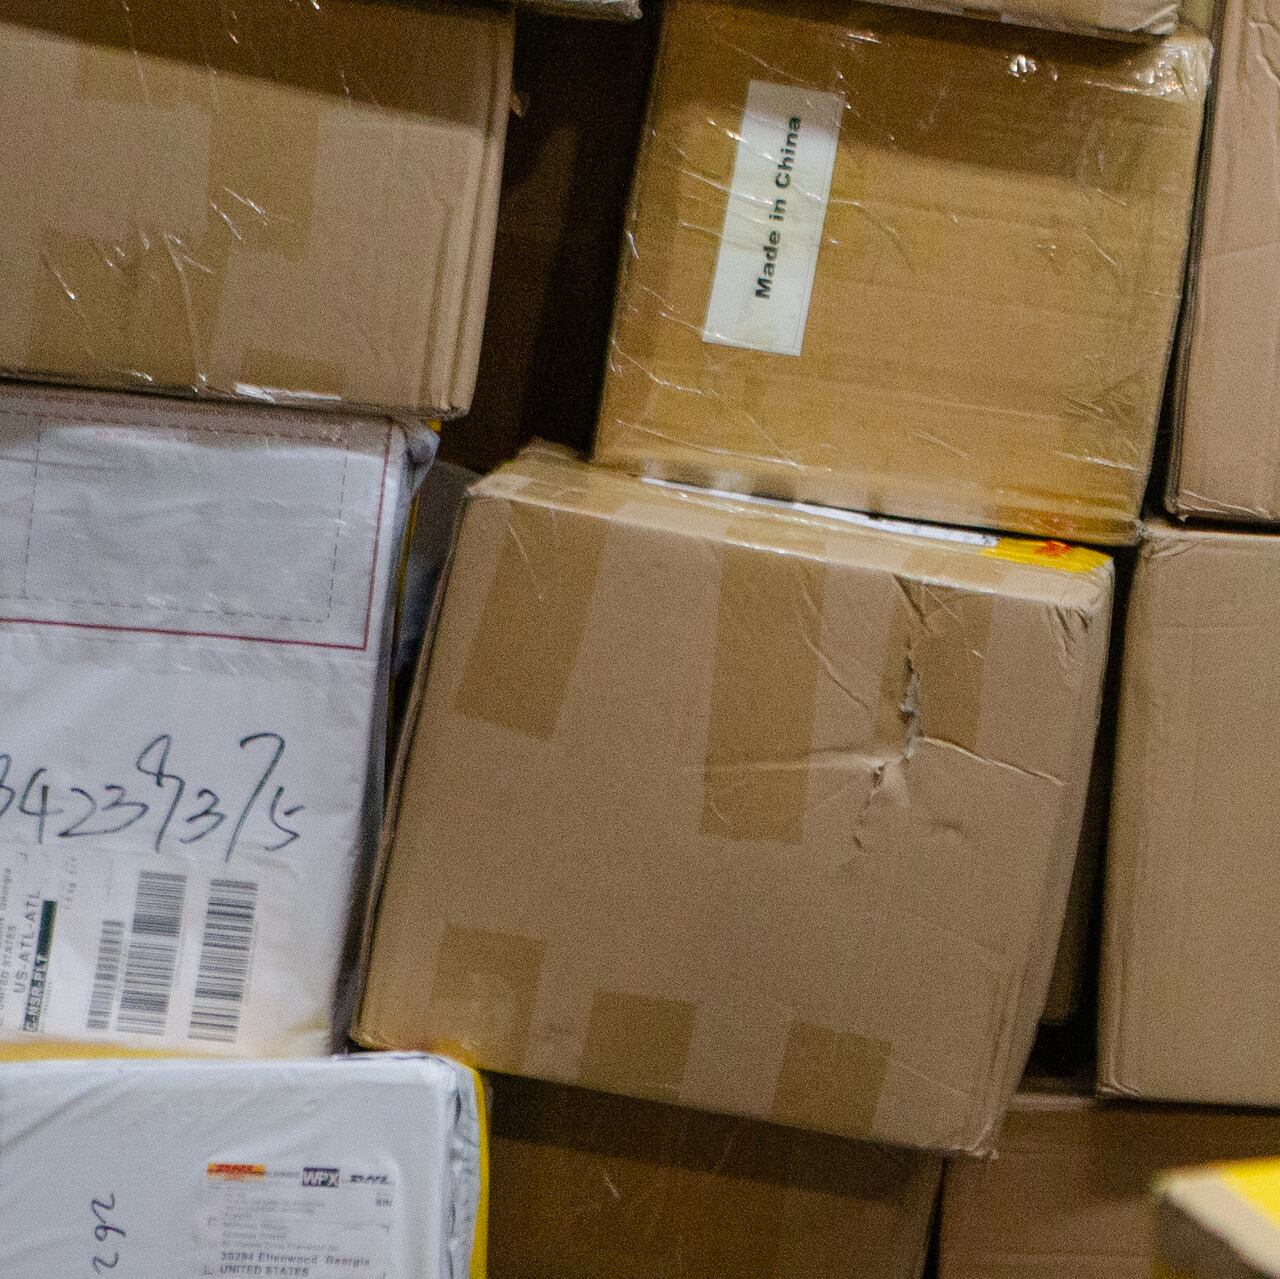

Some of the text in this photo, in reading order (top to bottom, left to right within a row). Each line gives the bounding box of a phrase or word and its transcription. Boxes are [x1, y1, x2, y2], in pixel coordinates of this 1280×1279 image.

[754, 116, 801, 300] Made in China
[13, 890, 41, 994] US-ATL-ATL
[302, 1172, 339, 1188] WPX
